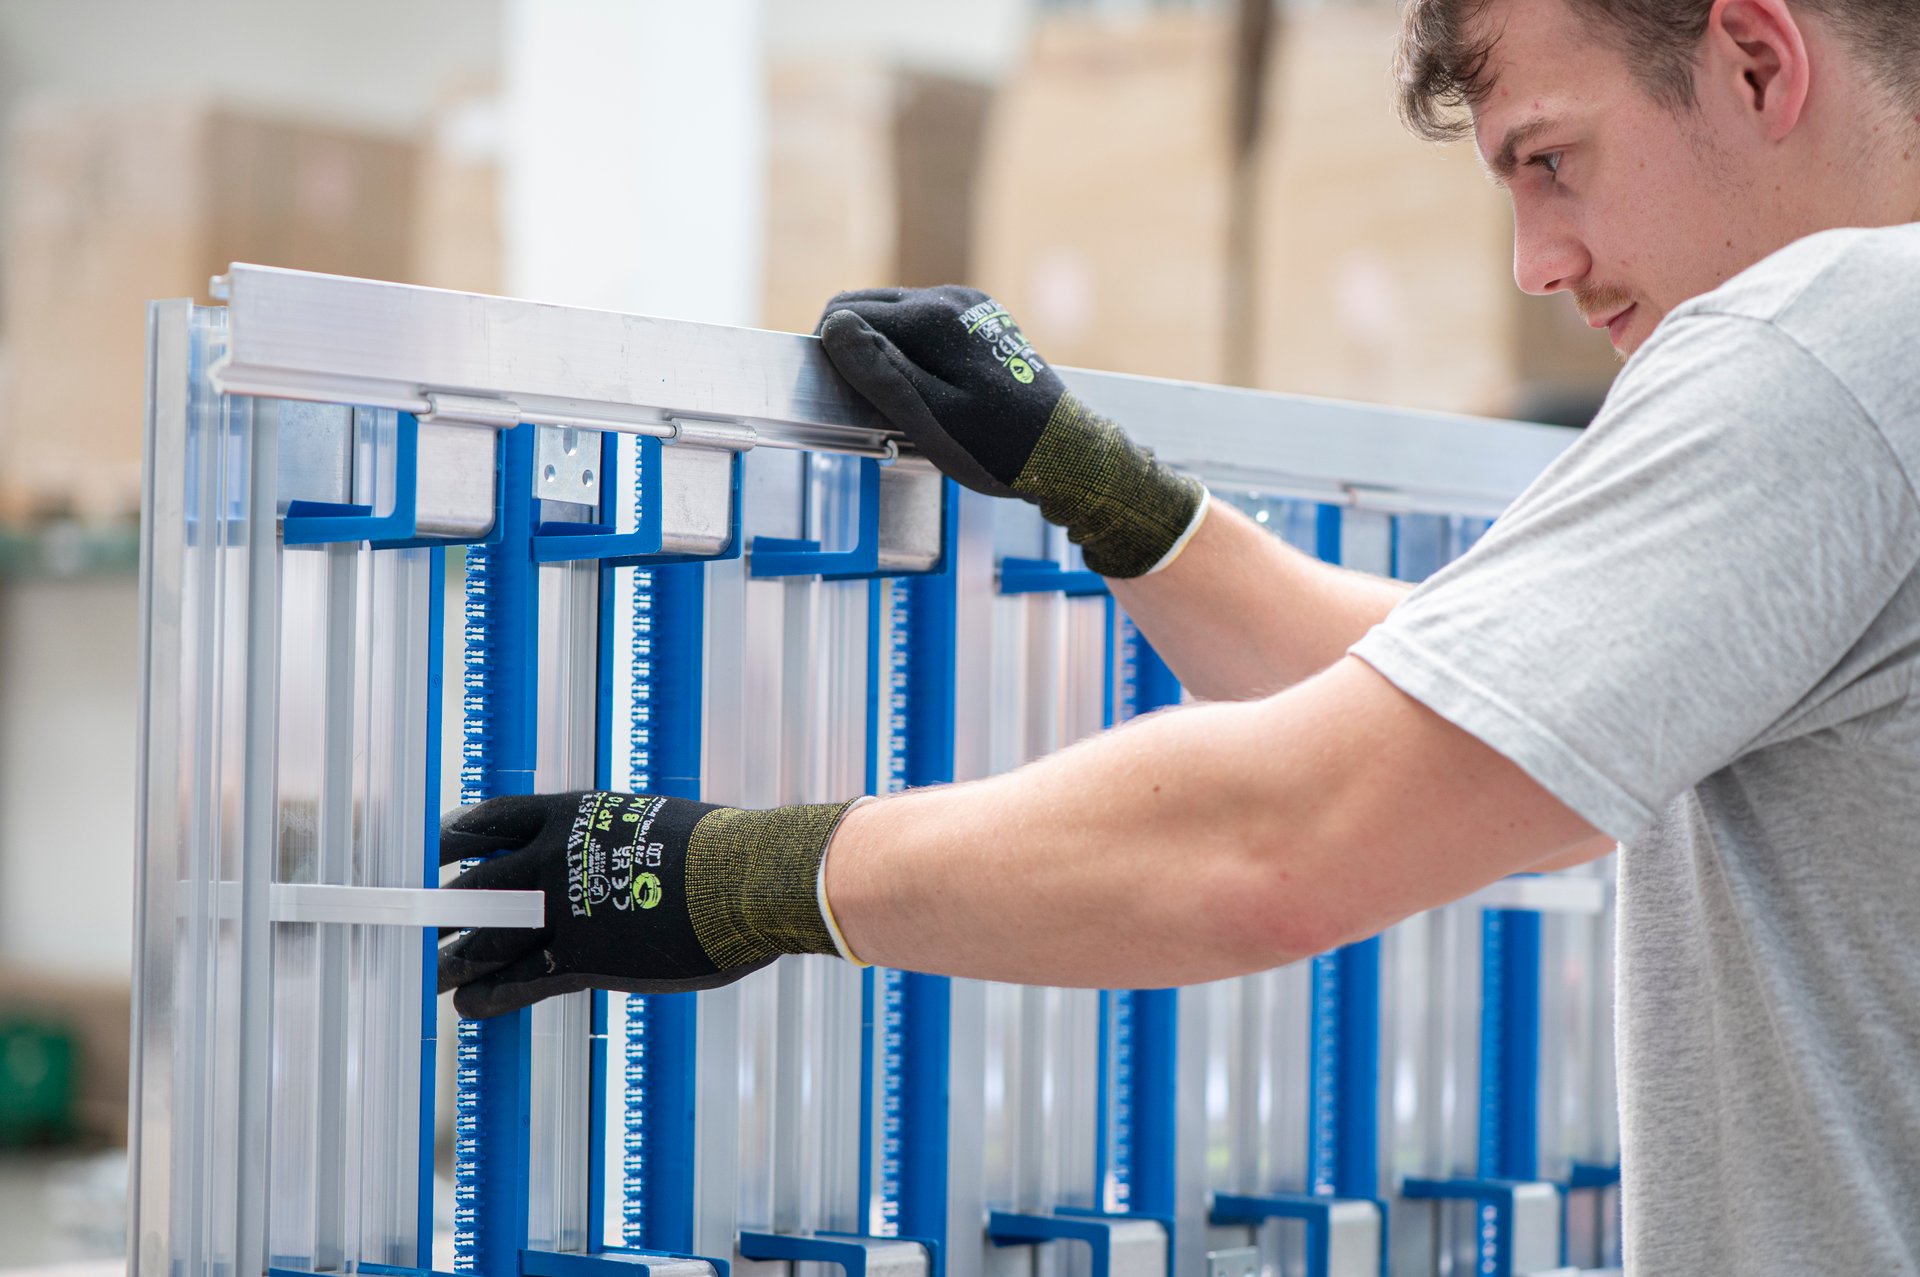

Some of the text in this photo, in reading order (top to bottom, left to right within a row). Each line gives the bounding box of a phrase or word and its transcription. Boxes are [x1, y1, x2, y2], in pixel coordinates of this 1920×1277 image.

[567, 792, 602, 918] PORTWEST
[634, 845, 645, 865] F28
[611, 876, 630, 911] CE
